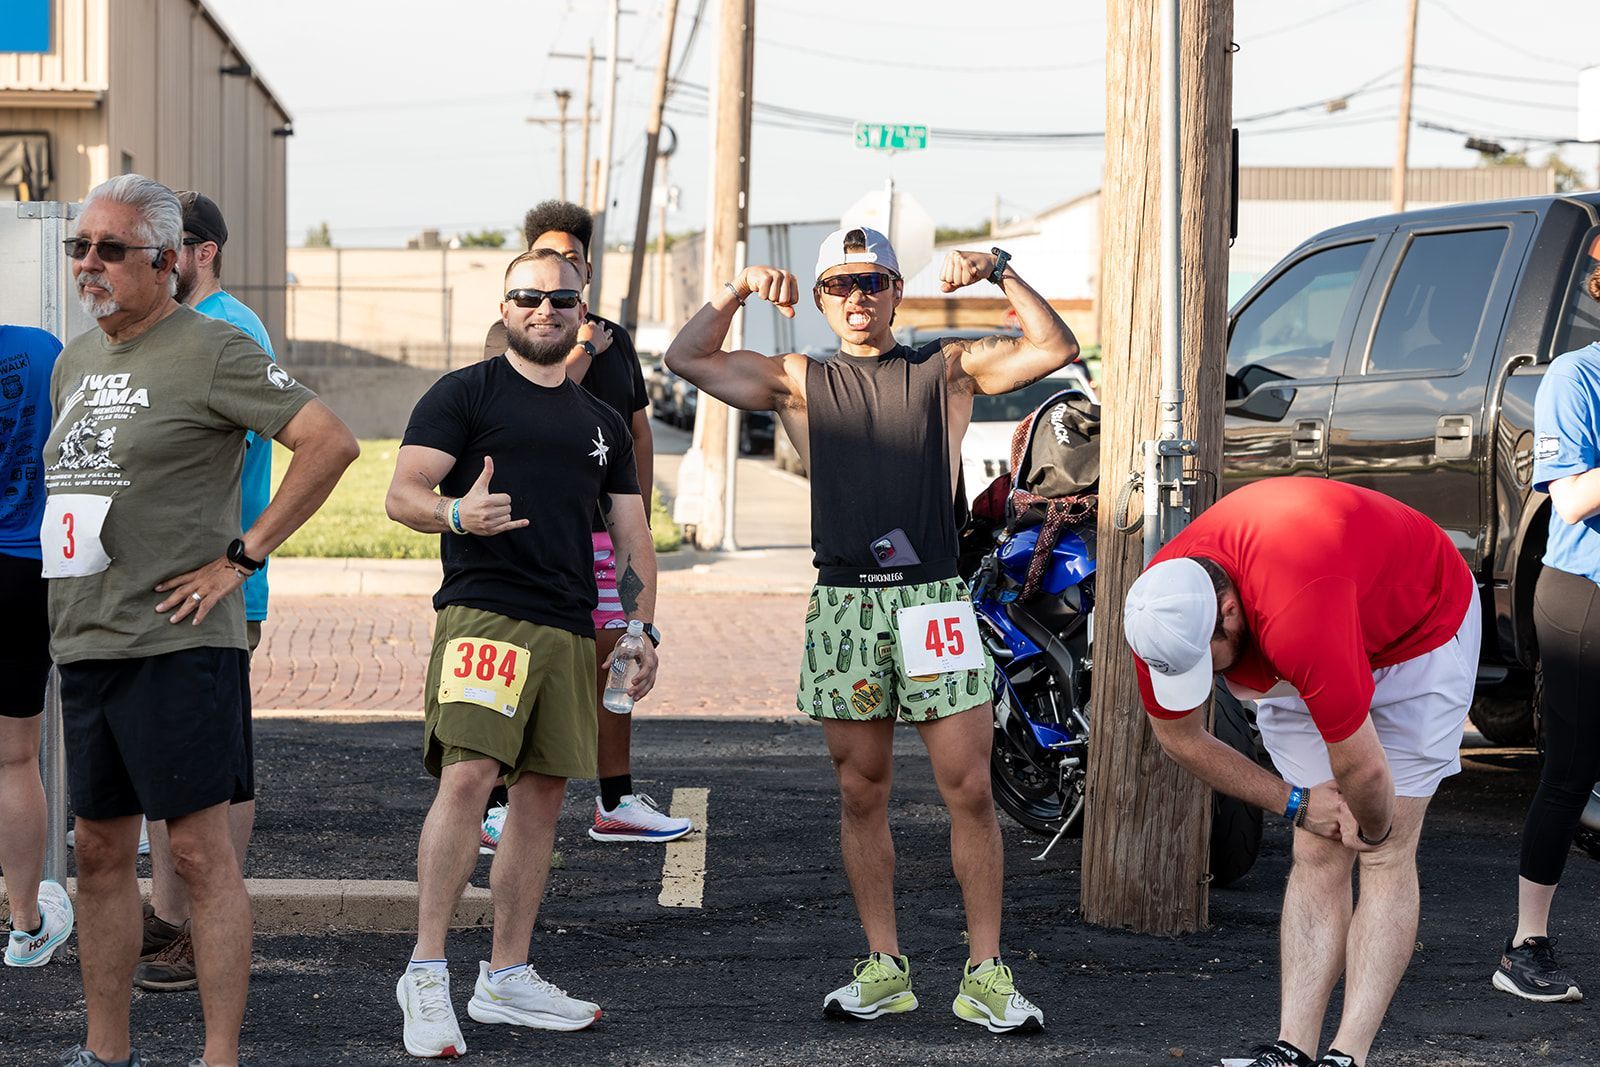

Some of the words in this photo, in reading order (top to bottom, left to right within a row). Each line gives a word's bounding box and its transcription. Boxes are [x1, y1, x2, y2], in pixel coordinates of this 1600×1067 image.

[80, 373, 131, 391] IWO
[84, 388, 150, 408] JIMA
[92, 405, 137, 415] MEMORIAL
[88, 472, 121, 480] FALLEN
[91, 479, 131, 487] SERVED
[62, 512, 75, 560] 3
[925, 617, 965, 657] 45
[453, 642, 518, 688] 384
